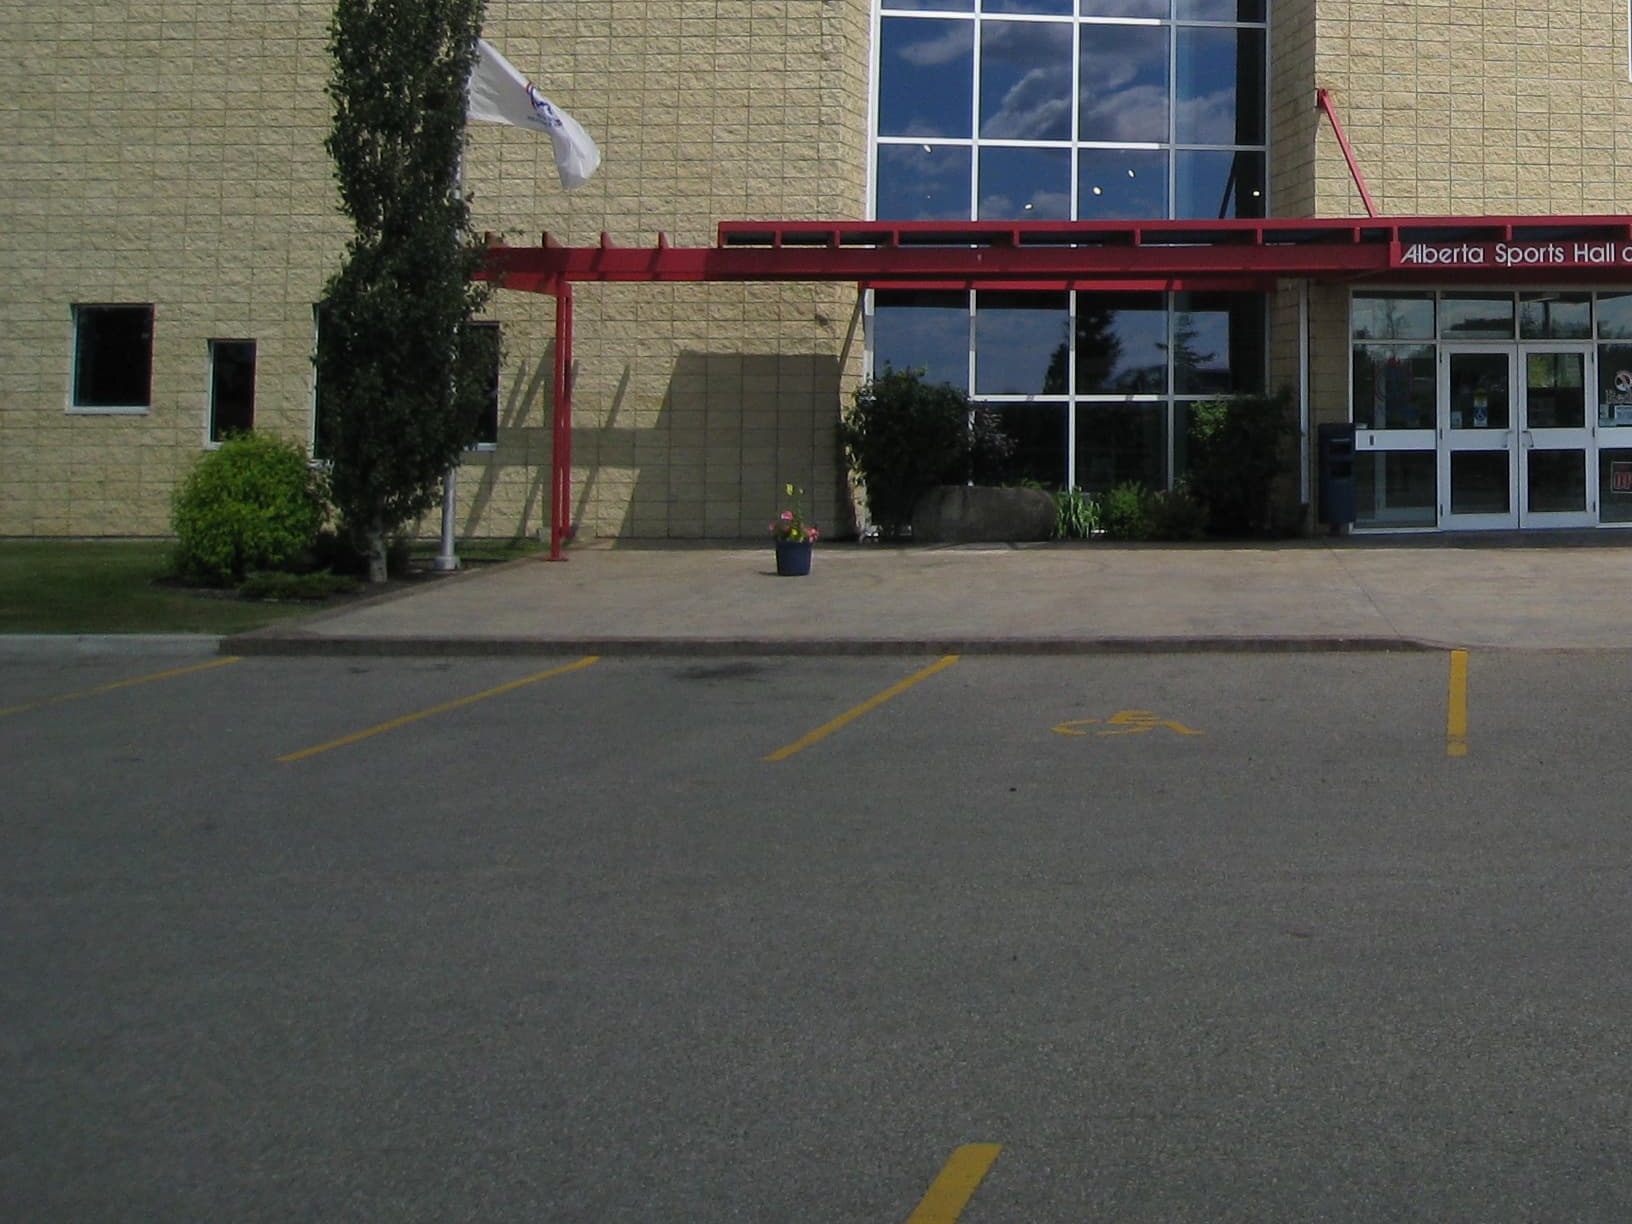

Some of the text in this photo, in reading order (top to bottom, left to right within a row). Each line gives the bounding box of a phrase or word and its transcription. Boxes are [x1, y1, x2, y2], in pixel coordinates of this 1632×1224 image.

[1400, 243, 1484, 264] Alberta
[1495, 243, 1565, 267] Sports
[1574, 242, 1615, 263] Hall
